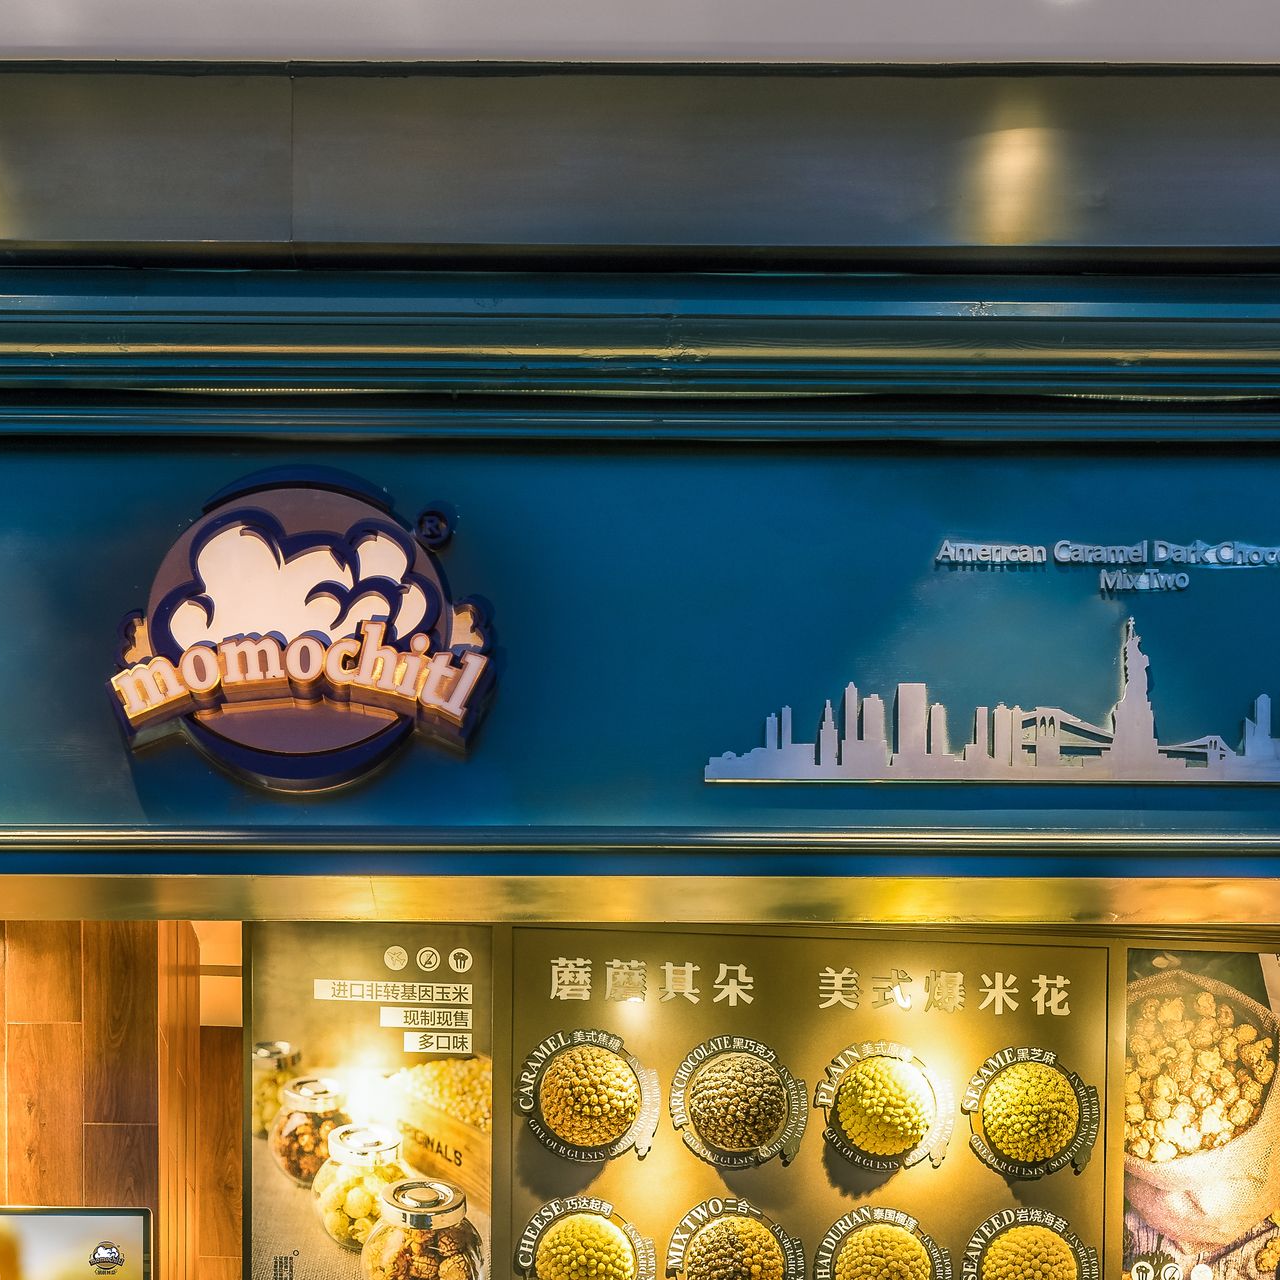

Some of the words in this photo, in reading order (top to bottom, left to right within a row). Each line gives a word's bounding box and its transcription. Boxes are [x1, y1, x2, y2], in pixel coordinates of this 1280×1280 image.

[935, 540, 1047, 563] American
[1053, 540, 1148, 563] Caramel
[1154, 540, 1210, 563] Dark
[1100, 569, 1140, 592] Mix
[1145, 569, 1190, 590] Two
[110, 619, 489, 719] momochitl
[331, 981, 469, 1003] 进口非转基因玉米
[549, 958, 755, 1007] 蘑蘑其朵
[817, 967, 1072, 1017] 美式爆米花
[403, 1010, 469, 1027] 现制现售
[418, 1034, 469, 1051] 多口味
[573, 1030, 622, 1051] 美式焦糖
[733, 1037, 777, 1063] 黑巧克力
[1016, 1047, 1057, 1065] 黑芝麻
[519, 1031, 571, 1110] CARAMEL
[675, 1036, 732, 1090] CHOCOLATE
[819, 1045, 861, 1105] PLAIN
[963, 1047, 1017, 1110] SESAME
[671, 1088, 689, 1128] DARK
[1069, 1073, 1090, 1123] DIFFERENT
[528, 1119, 546, 1141] GIVE
[547, 1138, 565, 1155] OUR
[567, 1149, 605, 1159] GUESTS
[826, 1127, 842, 1150] GIVE
[842, 1148, 861, 1165] OUR
[862, 1158, 899, 1169] GUESTS
[1051, 1122, 1089, 1168] SOMETHING
[1086, 1121, 1099, 1146] TALK
[971, 1134, 988, 1157] GIVE
[987, 1154, 1007, 1172] OUR
[1008, 1166, 1045, 1175] GUESTS
[566, 1199, 613, 1215] 巧达起司
[724, 1199, 762, 1215] 二合一
[873, 1209, 919, 1231] 泰国榴莲
[1016, 1209, 1068, 1232] 岩烧海苔
[519, 1199, 565, 1267] CHEESE
[667, 1228, 690, 1271] MIX
[681, 1198, 723, 1232] TWO
[822, 1206, 871, 1251] DURIAN
[773, 1226, 796, 1275] DIFFERENT
